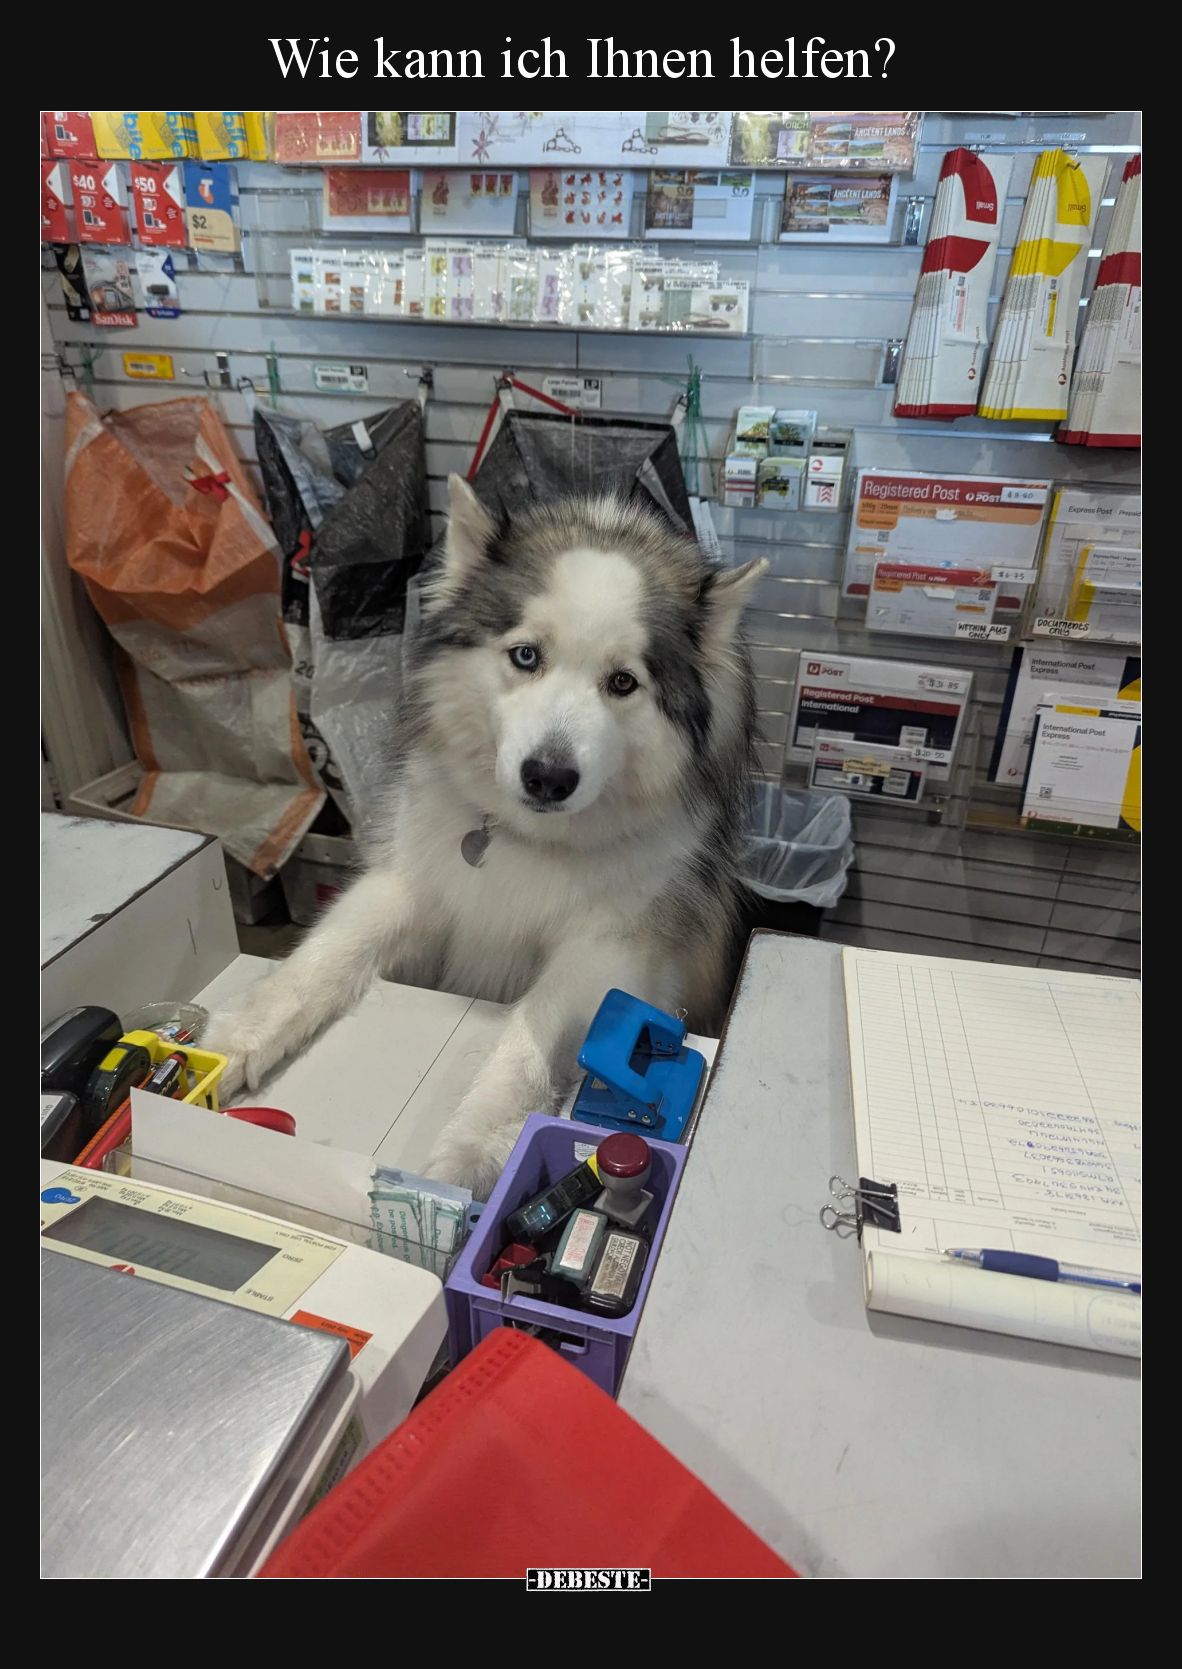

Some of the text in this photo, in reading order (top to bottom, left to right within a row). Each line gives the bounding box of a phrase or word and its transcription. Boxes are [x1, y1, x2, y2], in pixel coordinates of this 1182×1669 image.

[73, 175, 95, 191] $40
[134, 177, 156, 193] $50
[192, 215, 208, 230] $2
[94, 315, 135, 327] SanDisk
[864, 480, 960, 500] Registered Post
[1068, 506, 1095, 514] Express
[1096, 507, 1113, 515] Post
[1030, 665, 1059, 675] Express
[1031, 658, 1096, 670] International Post
[821, 669, 844, 677] POST
[802, 688, 875, 704] Registered Post
[800, 700, 860, 714] International
[1041, 731, 1071, 740] Express
[1043, 723, 1106, 737] International Post
[281, 1253, 304, 1263] ZERO
[245, 1288, 275, 1302] STABLE
